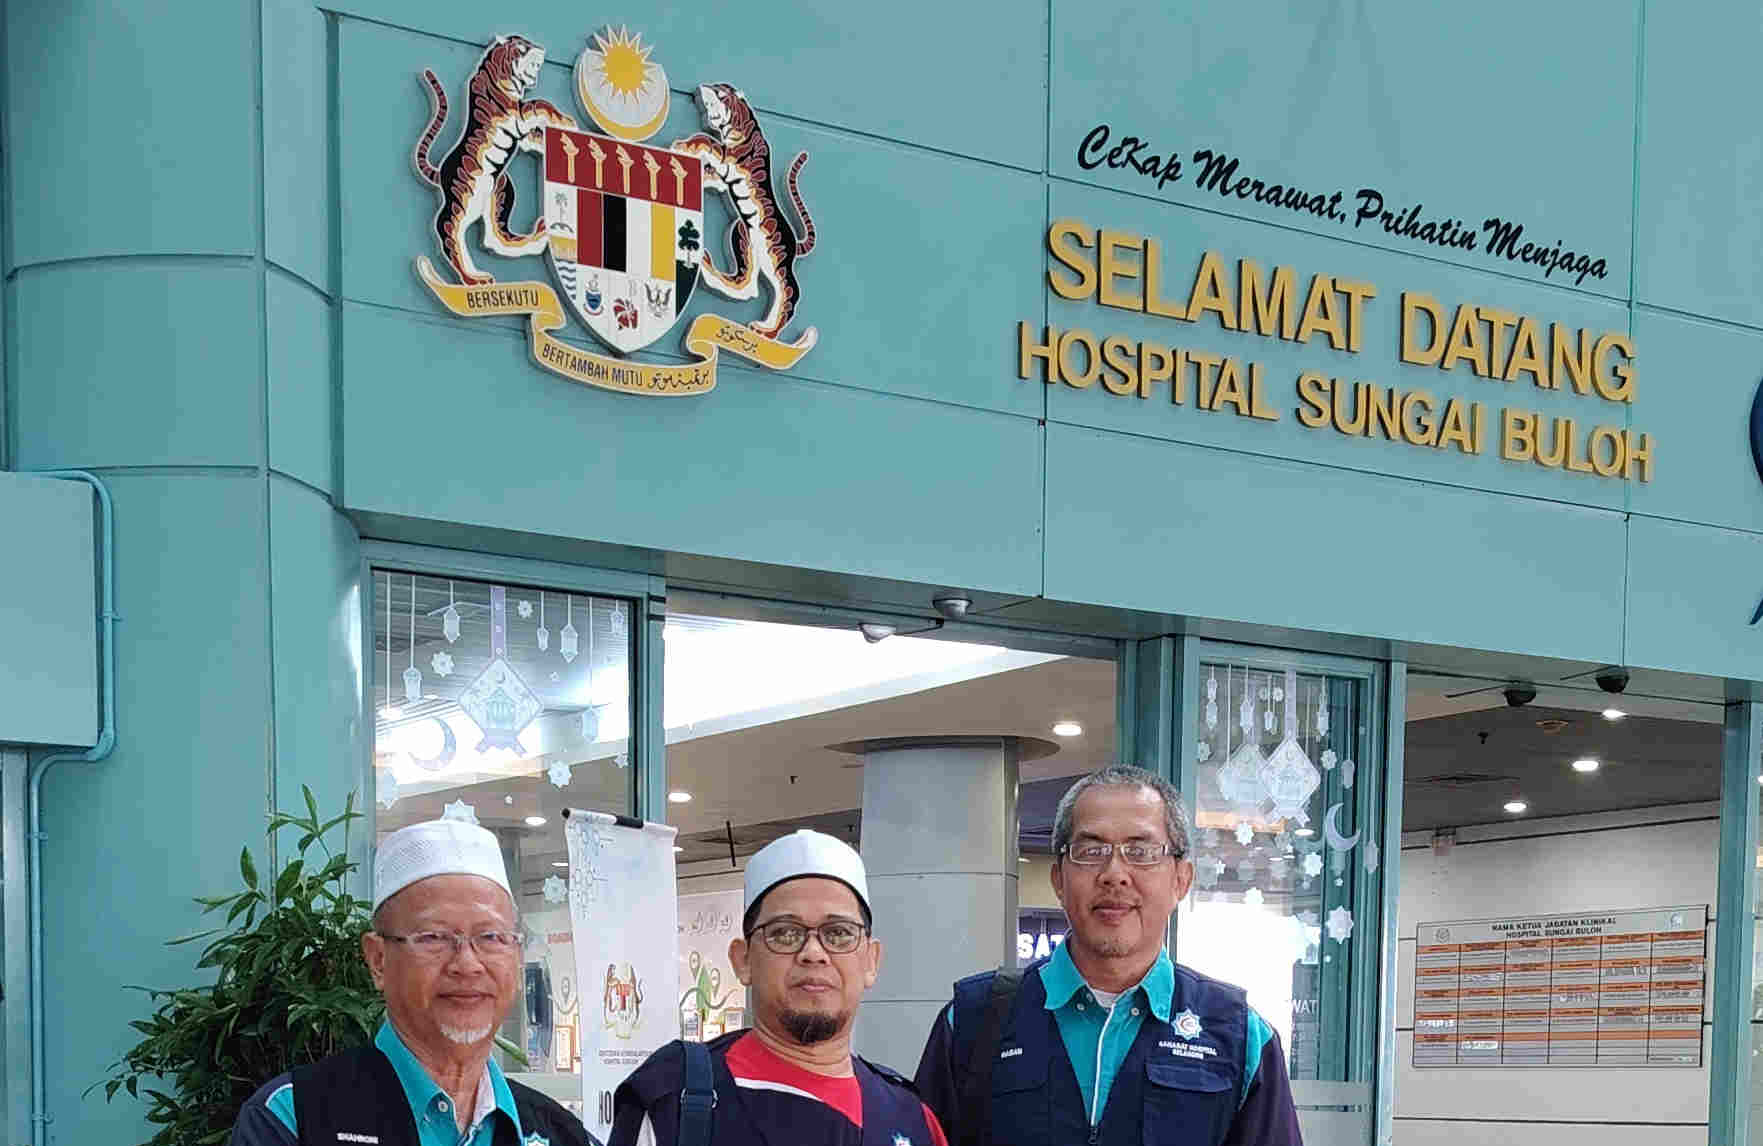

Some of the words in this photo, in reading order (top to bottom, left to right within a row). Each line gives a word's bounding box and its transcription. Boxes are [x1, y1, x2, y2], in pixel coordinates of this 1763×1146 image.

[1193, 149, 1345, 223] Merawat,
[1355, 189, 1477, 251] Prihatin
[1483, 218, 1608, 287] Menjaga
[466, 289, 539, 308] BERSEKUTU
[1045, 219, 1376, 354] SELAMAT
[1400, 291, 1636, 403] DATANG
[541, 343, 609, 380] BERTAMBAH
[611, 366, 643, 387] MUTU
[1018, 321, 1279, 422] HOSPITAL
[1296, 373, 1485, 455] SUNGAI
[1501, 409, 1654, 482] BULOH
[1505, 930, 1540, 939] HOSPITAL
